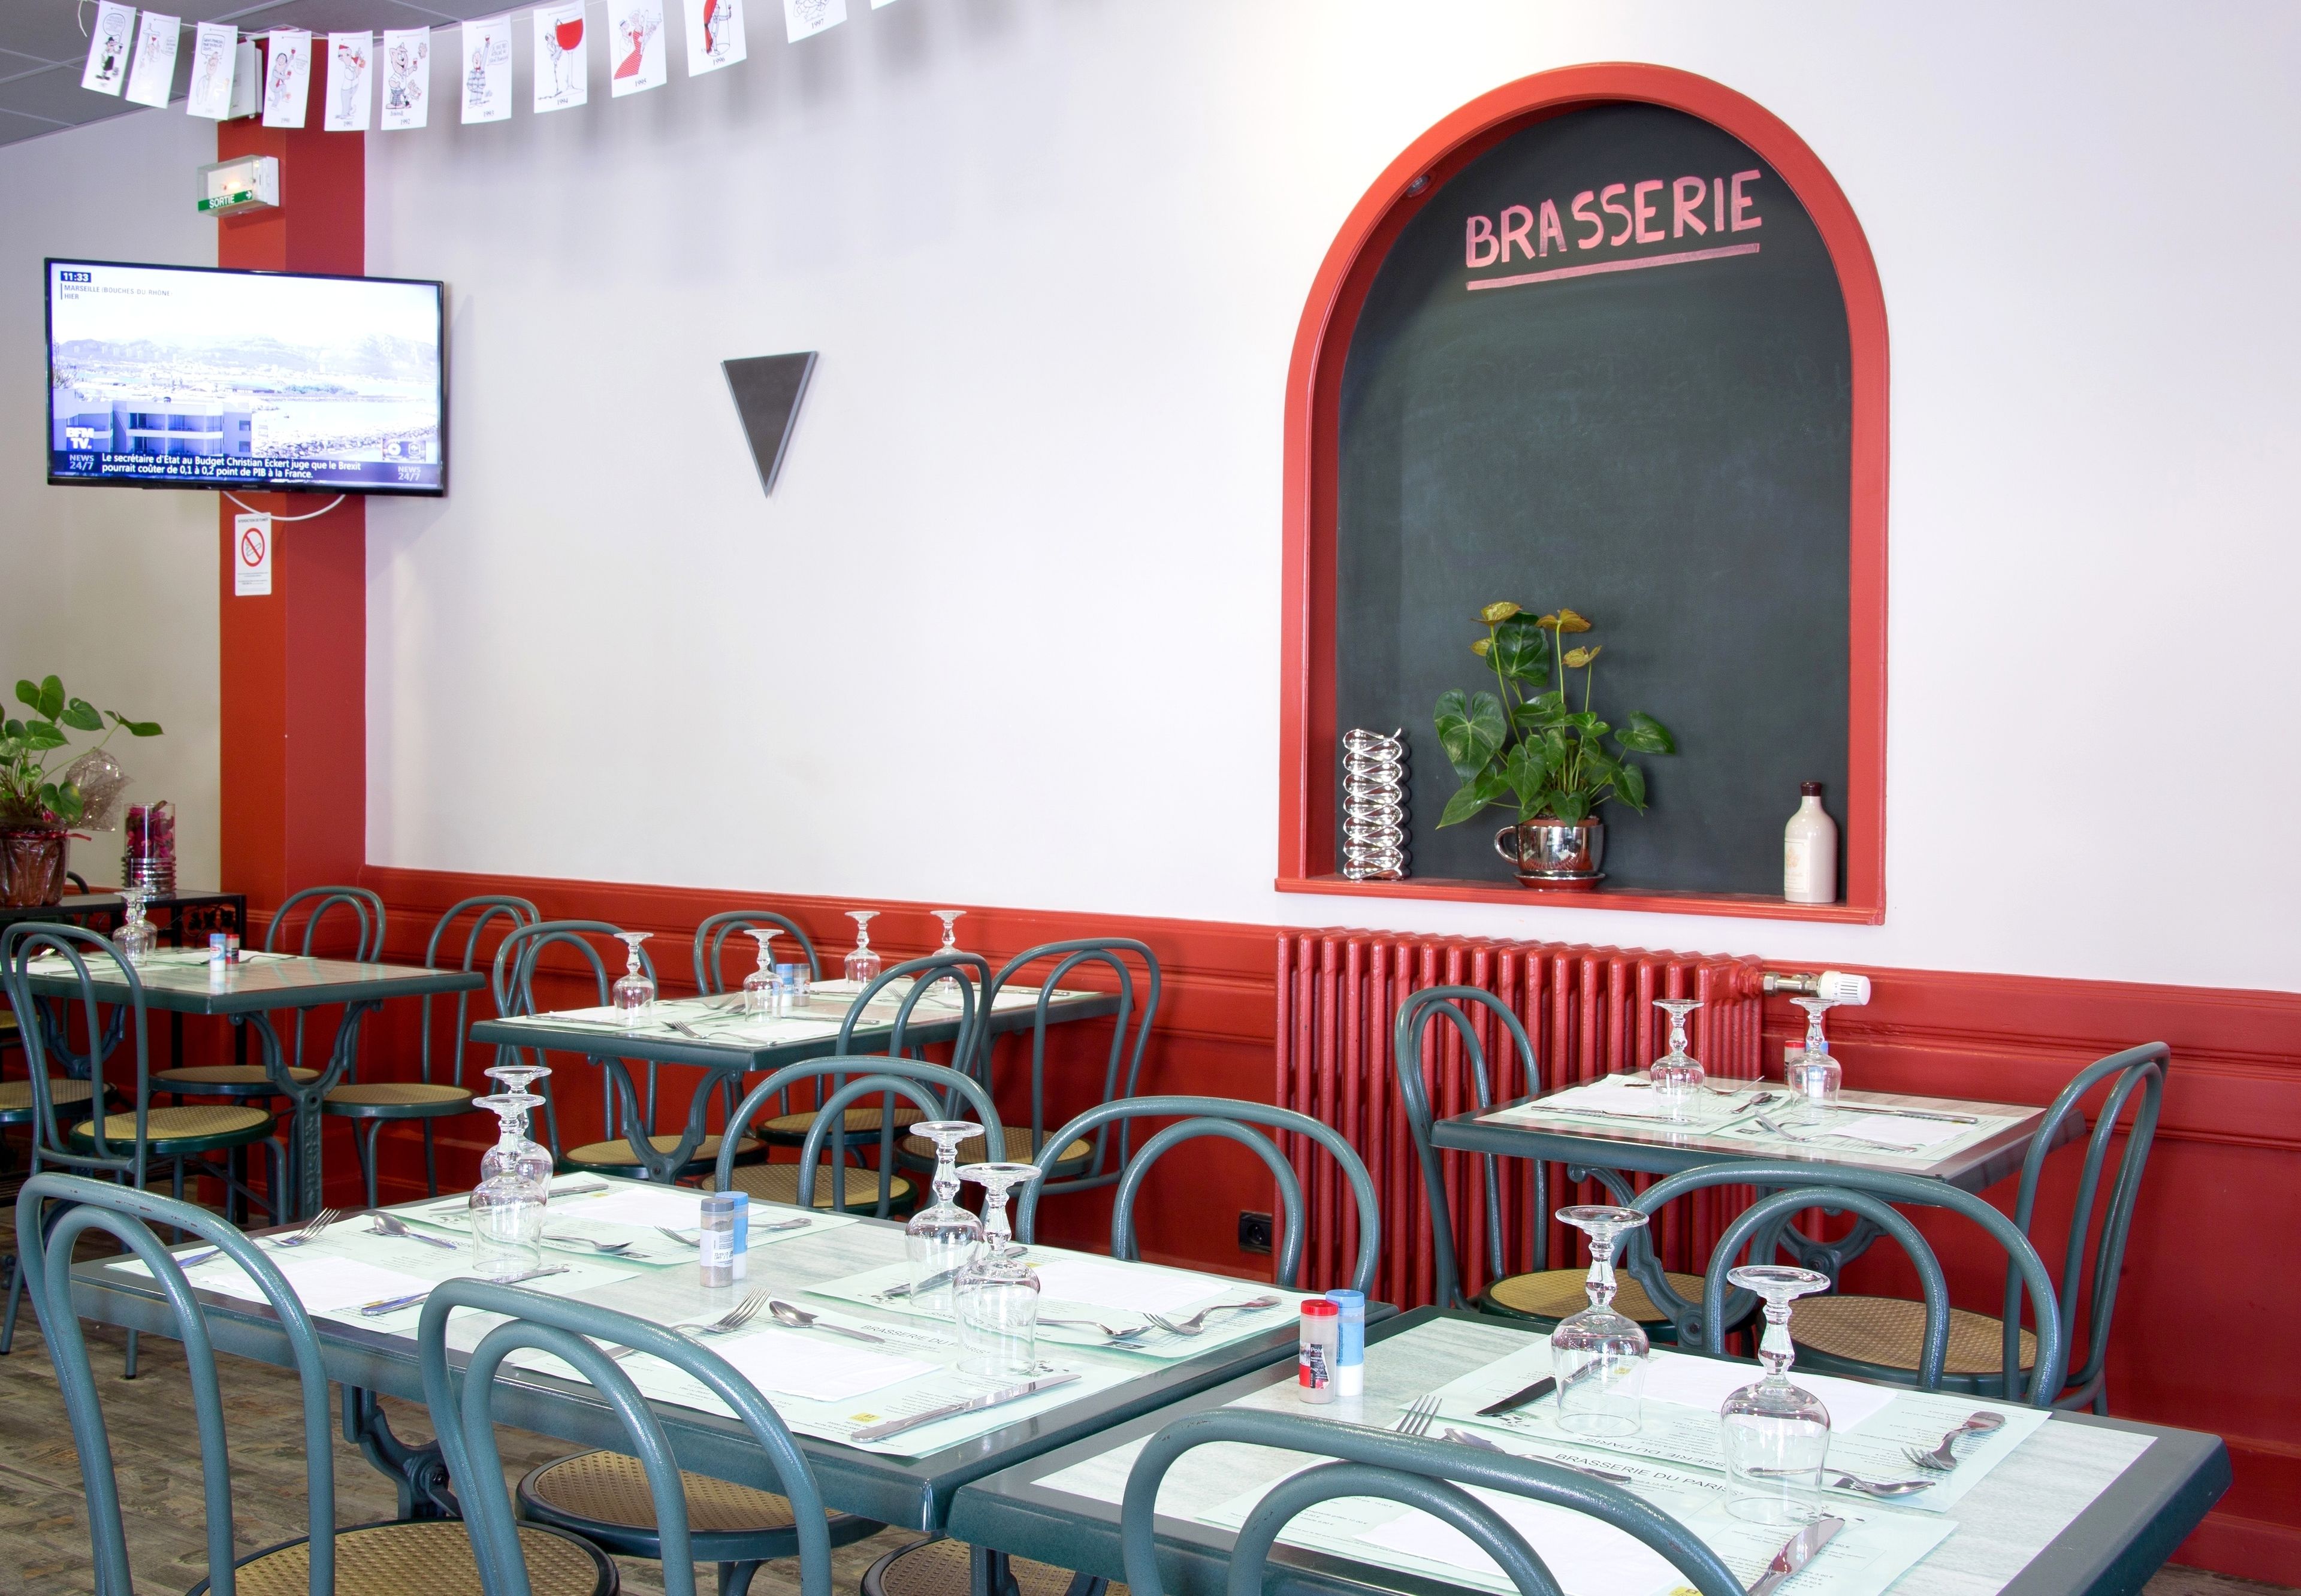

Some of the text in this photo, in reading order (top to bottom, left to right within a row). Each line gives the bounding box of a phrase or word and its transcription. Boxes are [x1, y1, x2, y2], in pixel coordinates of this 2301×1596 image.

[811, 19, 825, 29] 1997
[712, 56, 726, 65] 1996
[209, 195, 235, 208] SORTIE
[1466, 170, 1762, 268] BRASSERIE
[63, 273, 89, 282] 11:33
[66, 427, 94, 439] BFM
[70, 462, 93, 471] 24/7
[102, 454, 112, 462] Le
[114, 454, 153, 463] secrétaire
[195, 456, 225, 468] Budget
[227, 457, 263, 468] Christian
[265, 459, 289, 468] Eckert
[291, 461, 310, 471] juge
[312, 463, 328, 471] que
[329, 461, 337, 470] le
[339, 461, 361, 471] Brexit
[102, 464, 313, 478] pourrait coûter de 0,1 à 0,2 point de PIB à la France.
[398, 473, 420, 481] 24/7
[860, 1325, 927, 1341] BRASSERIE
[928, 1337, 949, 1346] DU
[1554, 1453, 1651, 1476] BRASSERIE
[1653, 1471, 1680, 1481] DU
